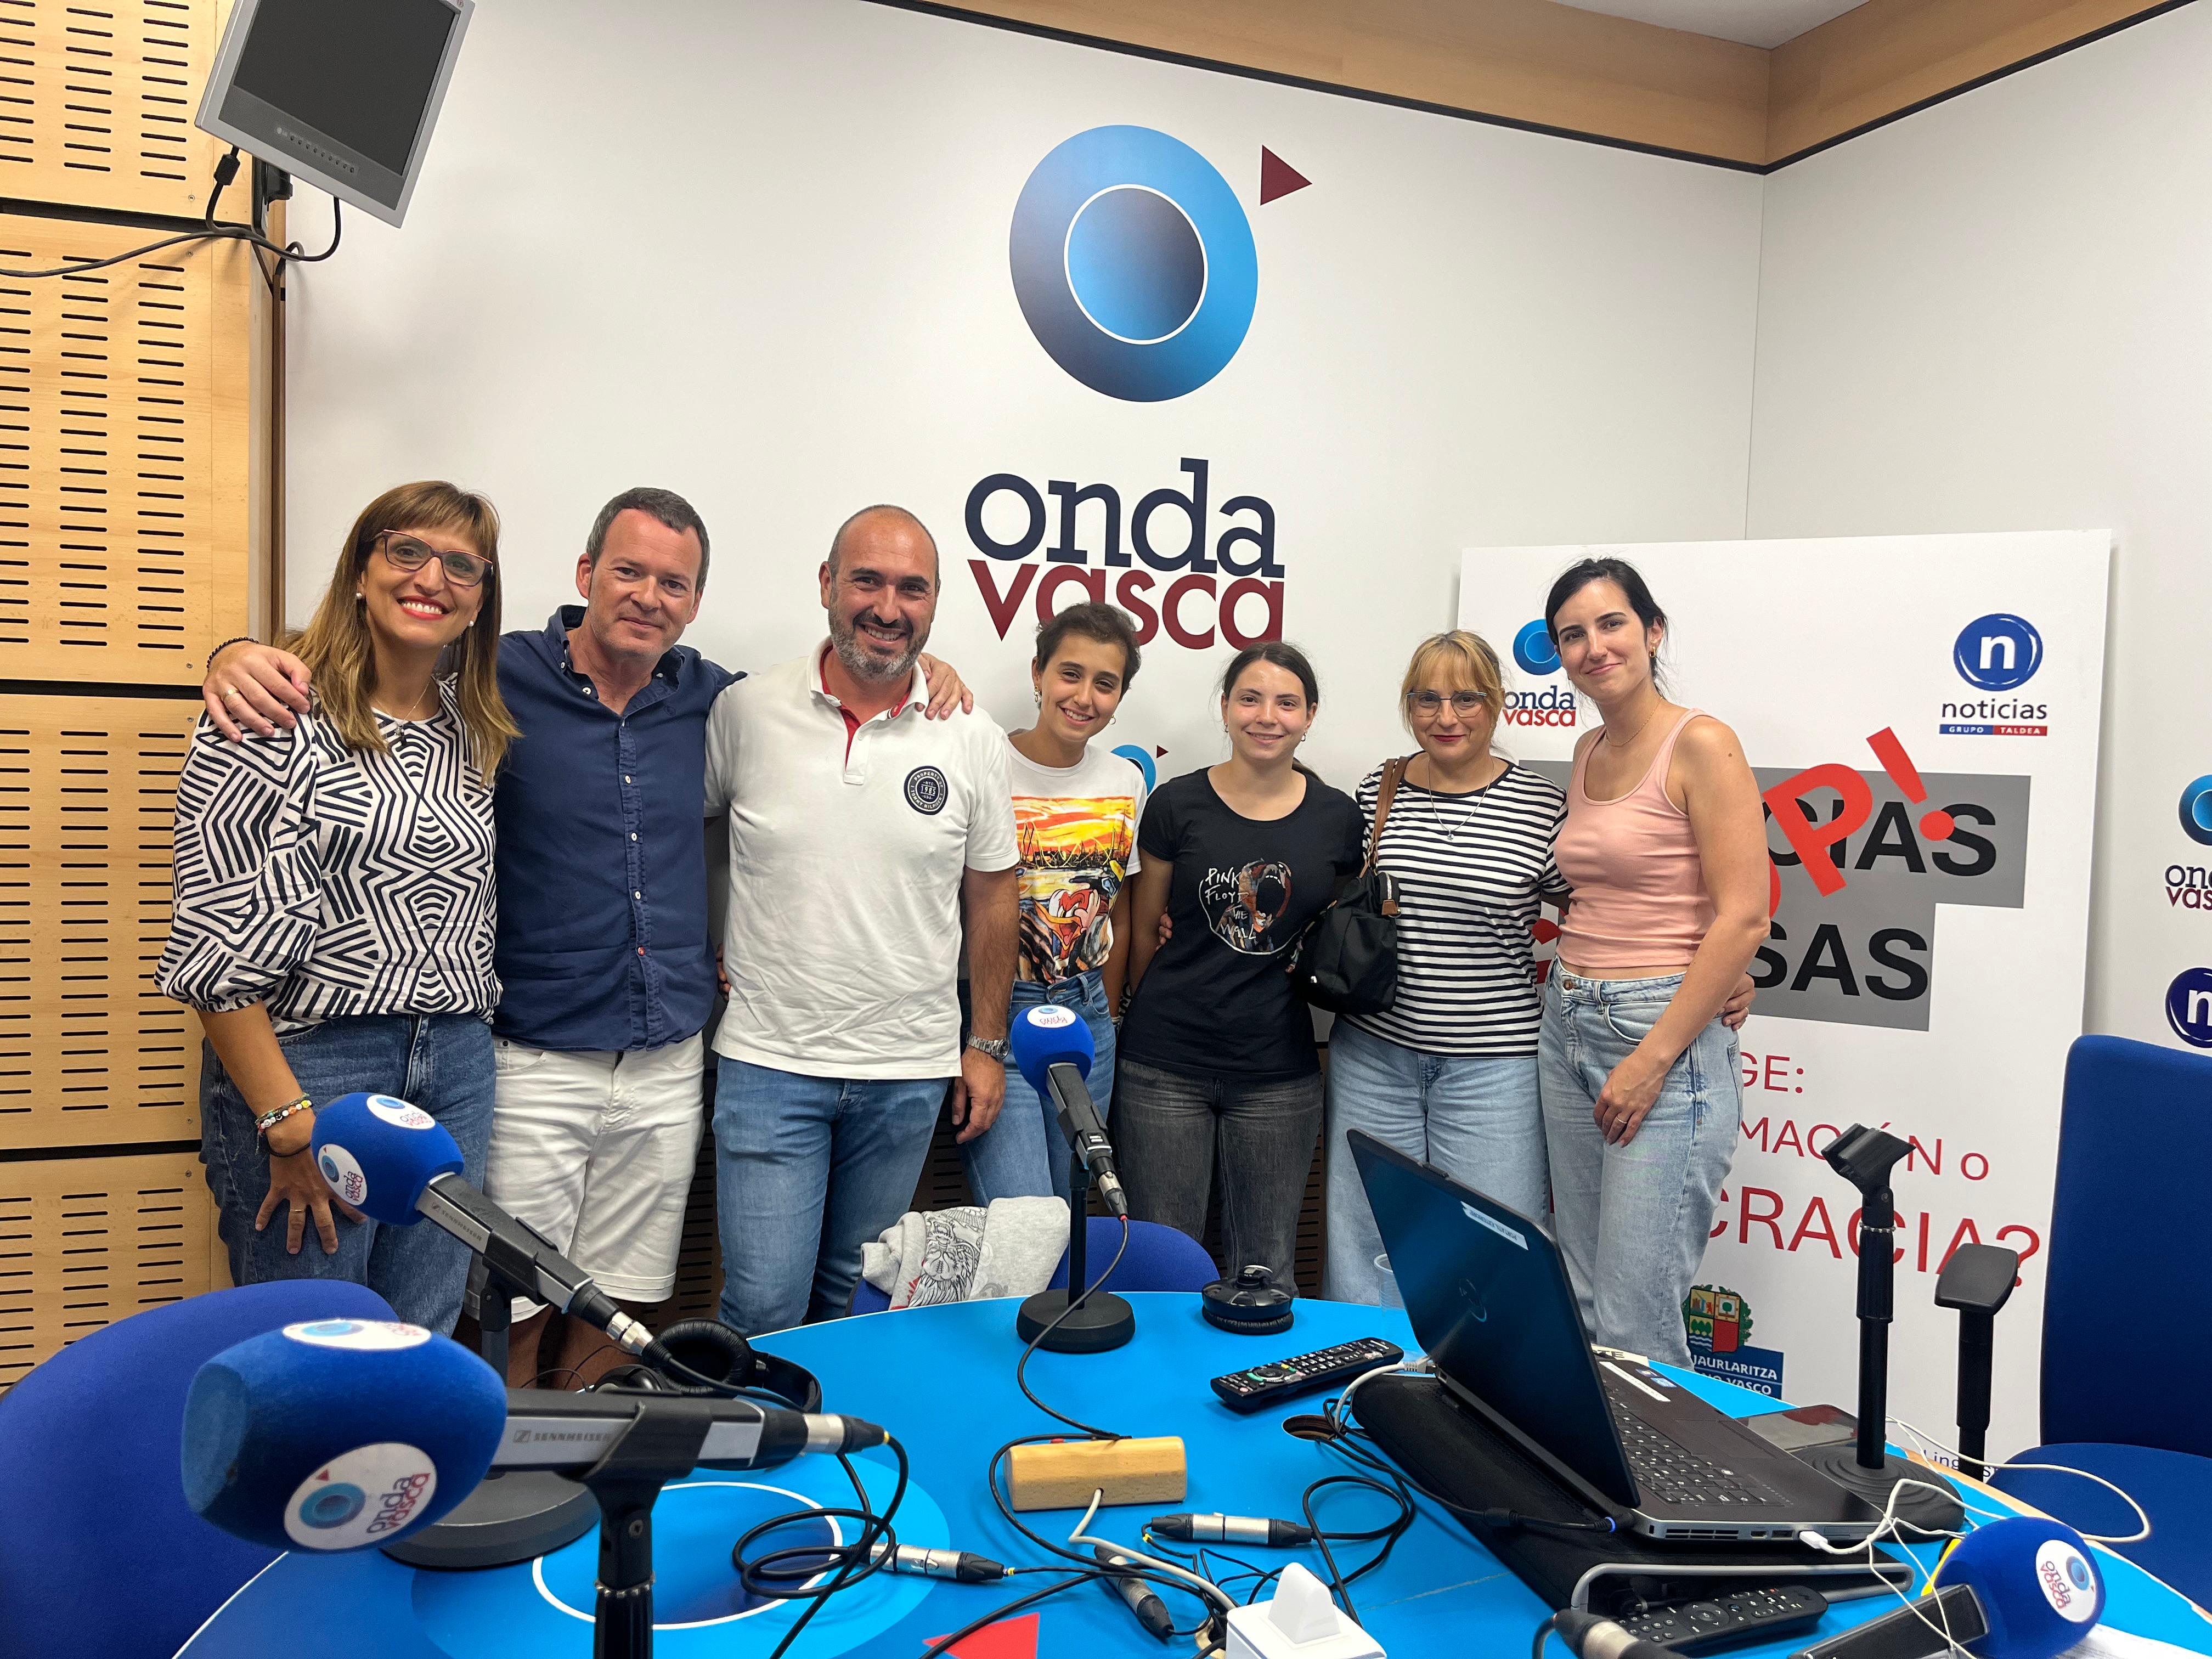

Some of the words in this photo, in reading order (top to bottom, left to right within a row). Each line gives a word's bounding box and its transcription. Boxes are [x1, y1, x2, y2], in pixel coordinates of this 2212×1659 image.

[964, 457, 1285, 578] onda
[1979, 636, 2016, 669] n
[1504, 685, 1576, 710] onda
[1942, 698, 2047, 719] noticias
[1502, 709, 1576, 727] vasca
[911, 789, 923, 805] TOMMY
[921, 786, 936, 795] 1985
[1205, 867, 1242, 889] PINK
[1204, 884, 1249, 905] FLOYD
[1226, 905, 1248, 919] THE
[1960, 1152, 1989, 1180] o
[343, 1171, 356, 1199] onda
[352, 1173, 363, 1201] vasca
[1693, 1355, 1778, 1380] JAURLARITZA
[366, 1476, 414, 1533] onda
[383, 1472, 431, 1531] vasca
[2040, 1564, 2067, 1609] vasca
[2045, 1560, 2071, 1605] onda
